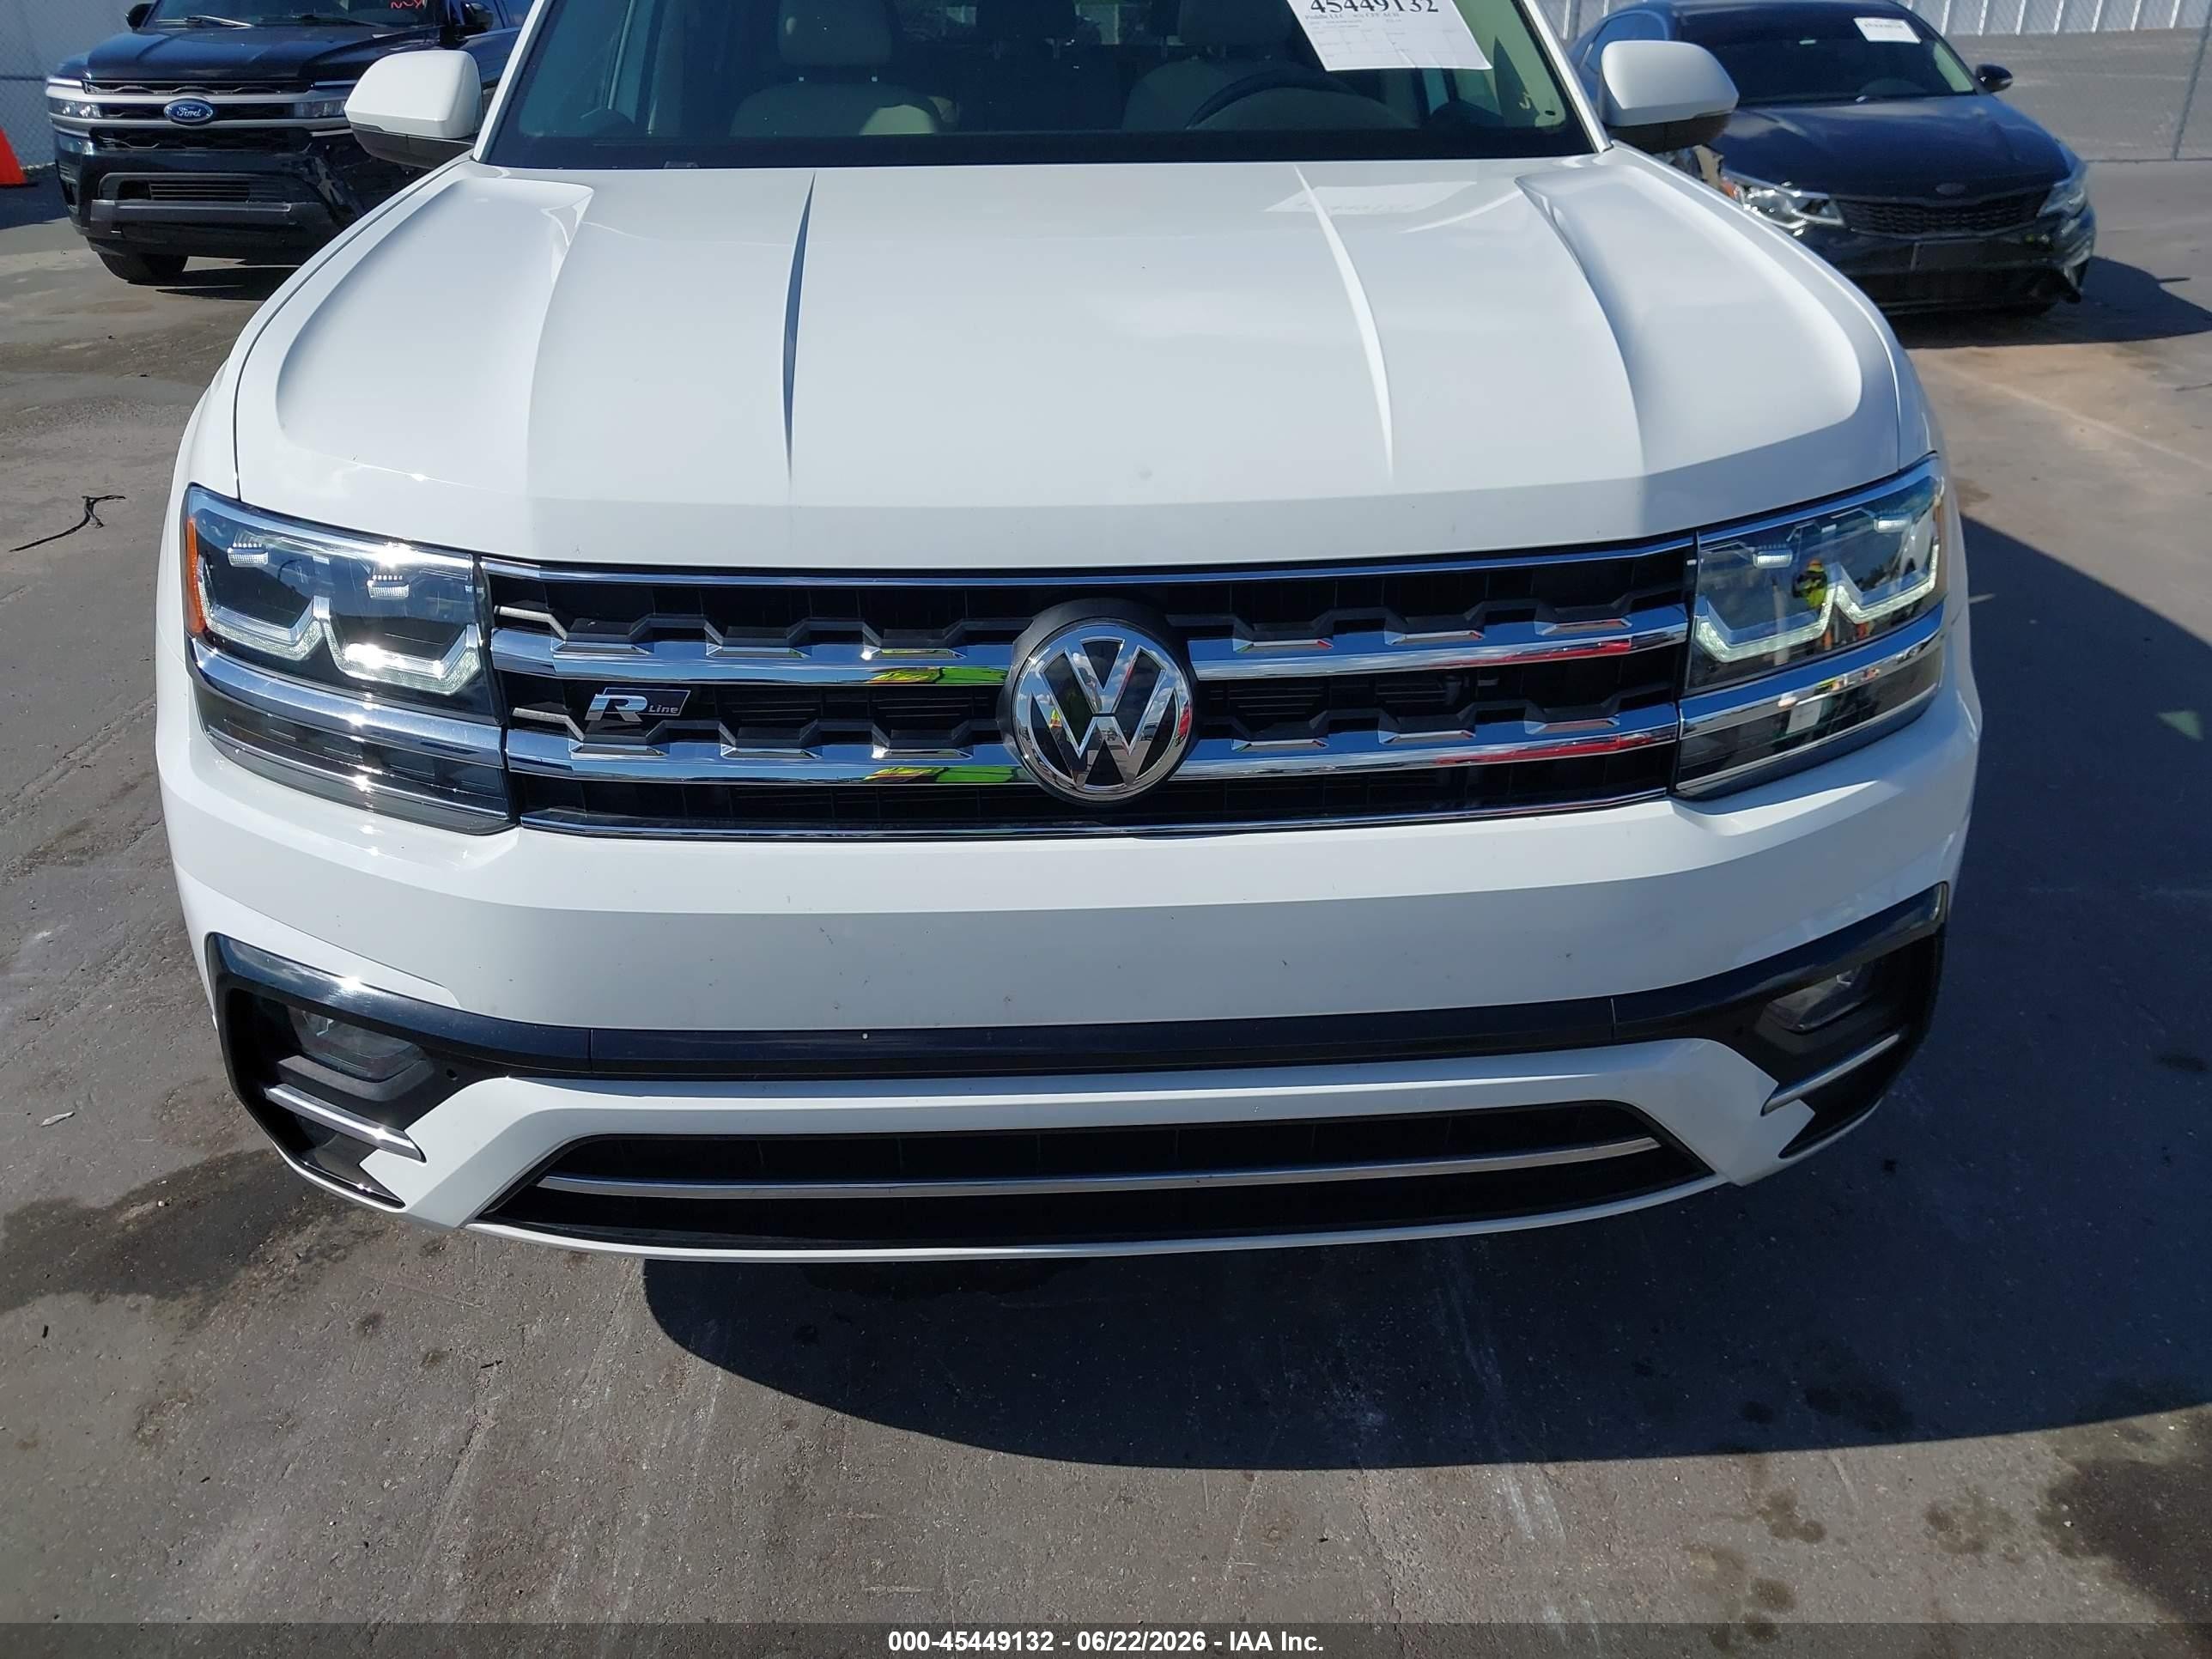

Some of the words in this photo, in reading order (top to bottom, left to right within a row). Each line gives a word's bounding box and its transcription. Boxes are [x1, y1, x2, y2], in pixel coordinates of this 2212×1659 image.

[176, 106, 202, 117] Ford
[585, 694, 643, 722] R
[647, 704, 679, 714] Line
